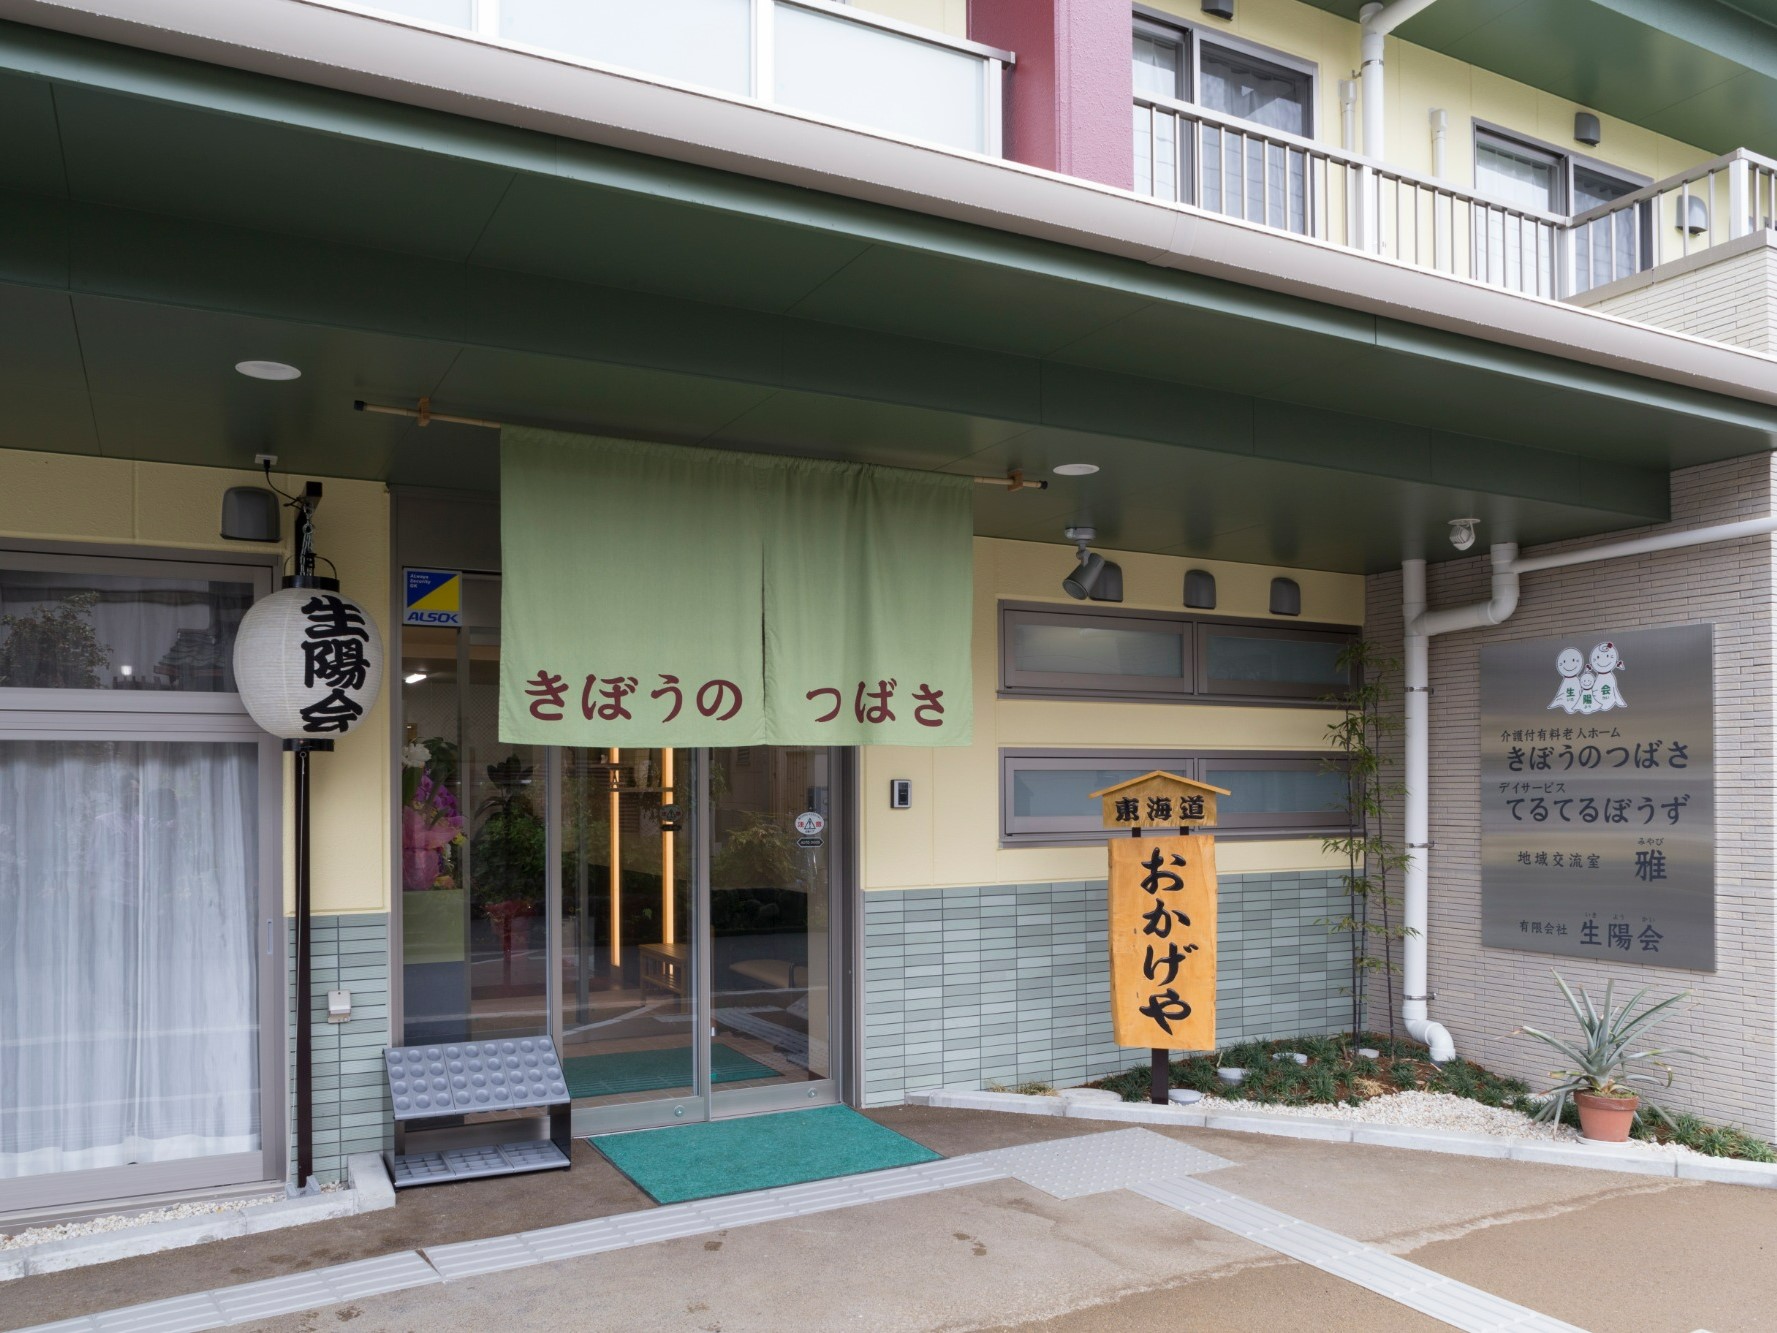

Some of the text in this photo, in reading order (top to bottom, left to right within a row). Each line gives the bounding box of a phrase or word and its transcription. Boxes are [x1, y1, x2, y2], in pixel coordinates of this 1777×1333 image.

[407, 611, 459, 624] ALSOK
[300, 595, 371, 733] 生陽会
[524, 670, 945, 727] きぼうの つばさ
[1501, 727, 1621, 742] 介護付有料老人ホーム
[1507, 740, 1689, 772] きぼうのつばさ
[1499, 782, 1566, 794] デイサービス
[1115, 795, 1205, 821] 東海道
[1506, 793, 1691, 825] てるてるぼうず
[1637, 837, 1665, 846] みやび
[1518, 849, 1667, 882] 地域交流室 雅
[1139, 847, 1199, 1036] おかげや
[1519, 919, 1664, 952] 有限会社 生陽会
